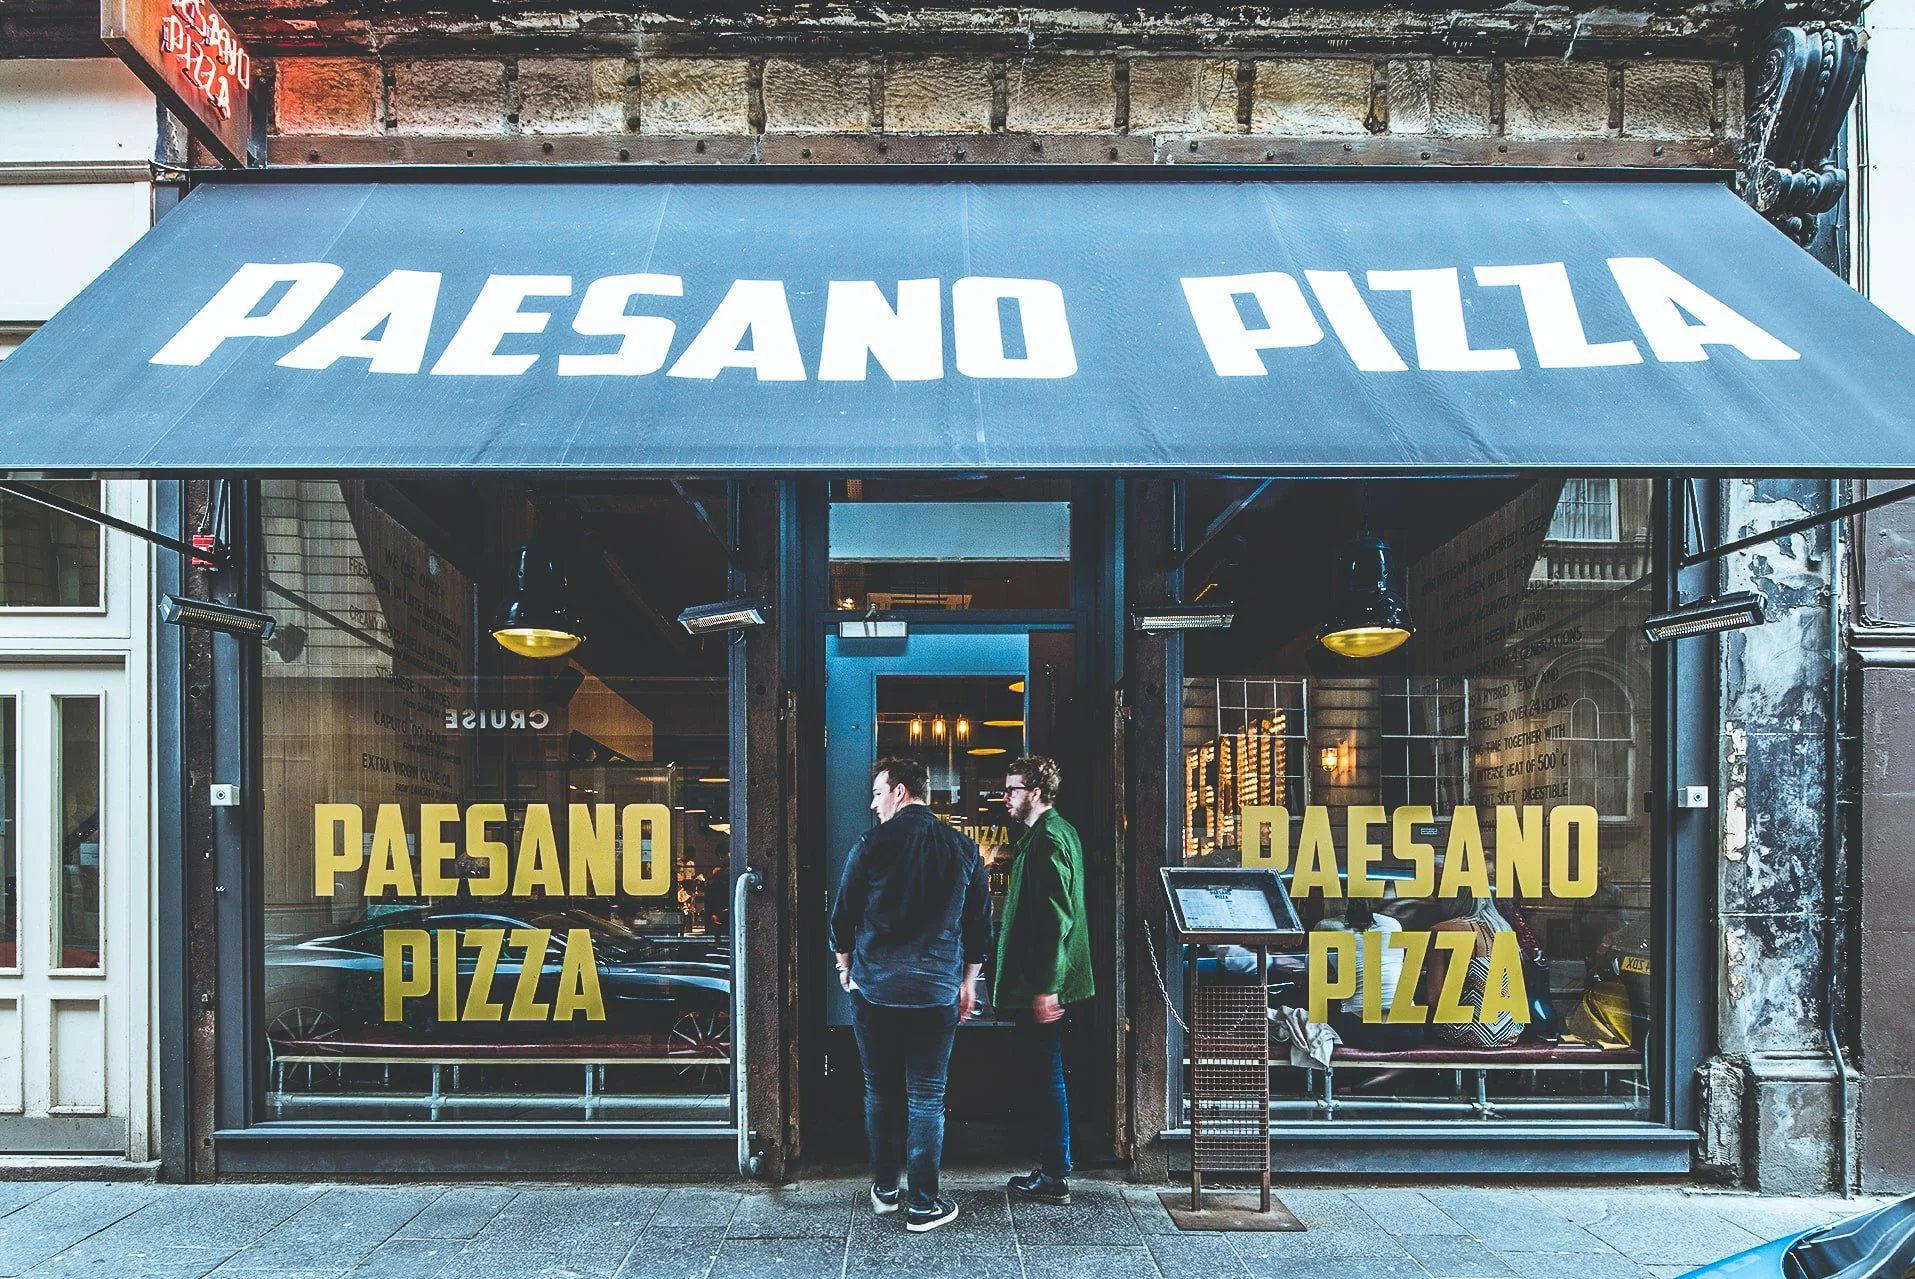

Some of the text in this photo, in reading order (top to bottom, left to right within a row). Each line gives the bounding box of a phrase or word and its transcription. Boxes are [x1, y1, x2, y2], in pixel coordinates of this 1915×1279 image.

[161, 14, 232, 120] PIZZA
[149, 258, 1802, 381] PAESANO PIZZA
[362, 752, 391, 774] EXTRA
[1504, 728, 1542, 749] TOGETHER
[1543, 723, 1566, 742] WITH
[1506, 760, 1524, 777] HEAT
[1525, 758, 1536, 774] OF
[963, 825, 1010, 846] PIZZA
[1521, 781, 1569, 803] DIGESTIBLE
[315, 803, 671, 897] PAESANO
[1241, 805, 1599, 899] PAESANO
[383, 929, 606, 1022] PIZZA
[1308, 931, 1531, 1023] PIZZA
